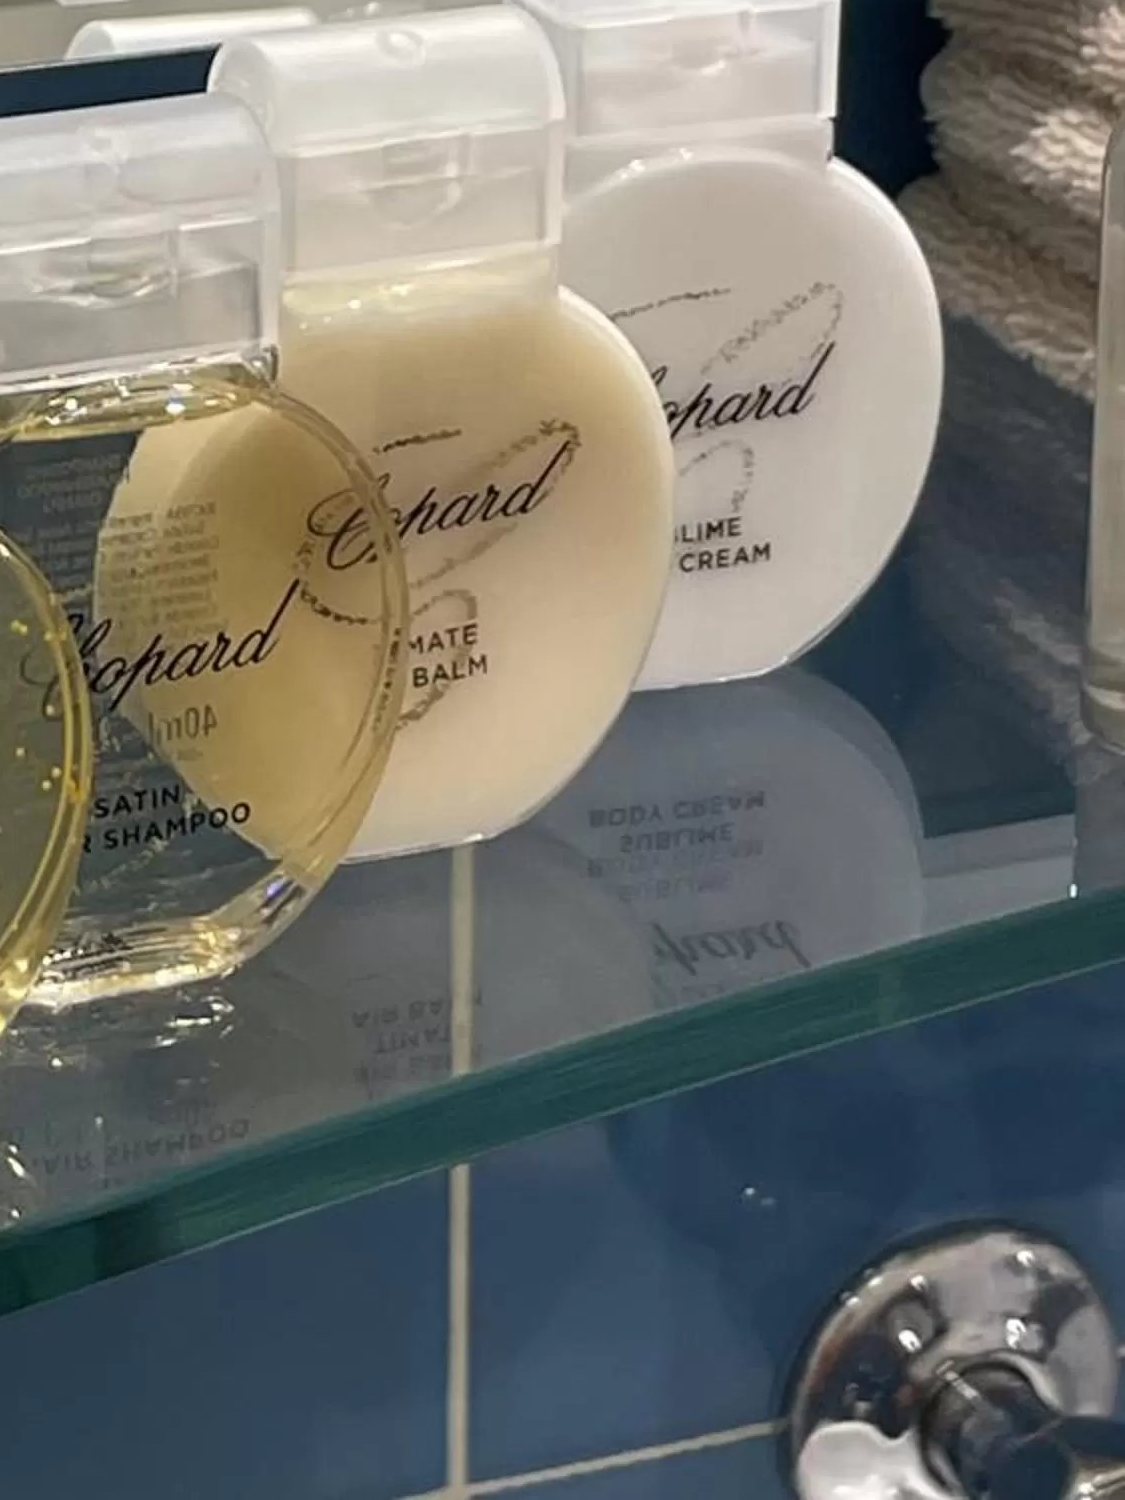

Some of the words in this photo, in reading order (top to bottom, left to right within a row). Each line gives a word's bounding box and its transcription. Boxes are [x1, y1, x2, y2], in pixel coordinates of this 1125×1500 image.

[674, 516, 743, 544] LIME
[679, 542, 772, 573] CREAM
[412, 654, 488, 688] BALM
[94, 783, 180, 819] SATIN
[103, 802, 251, 850] SHAMPOO
